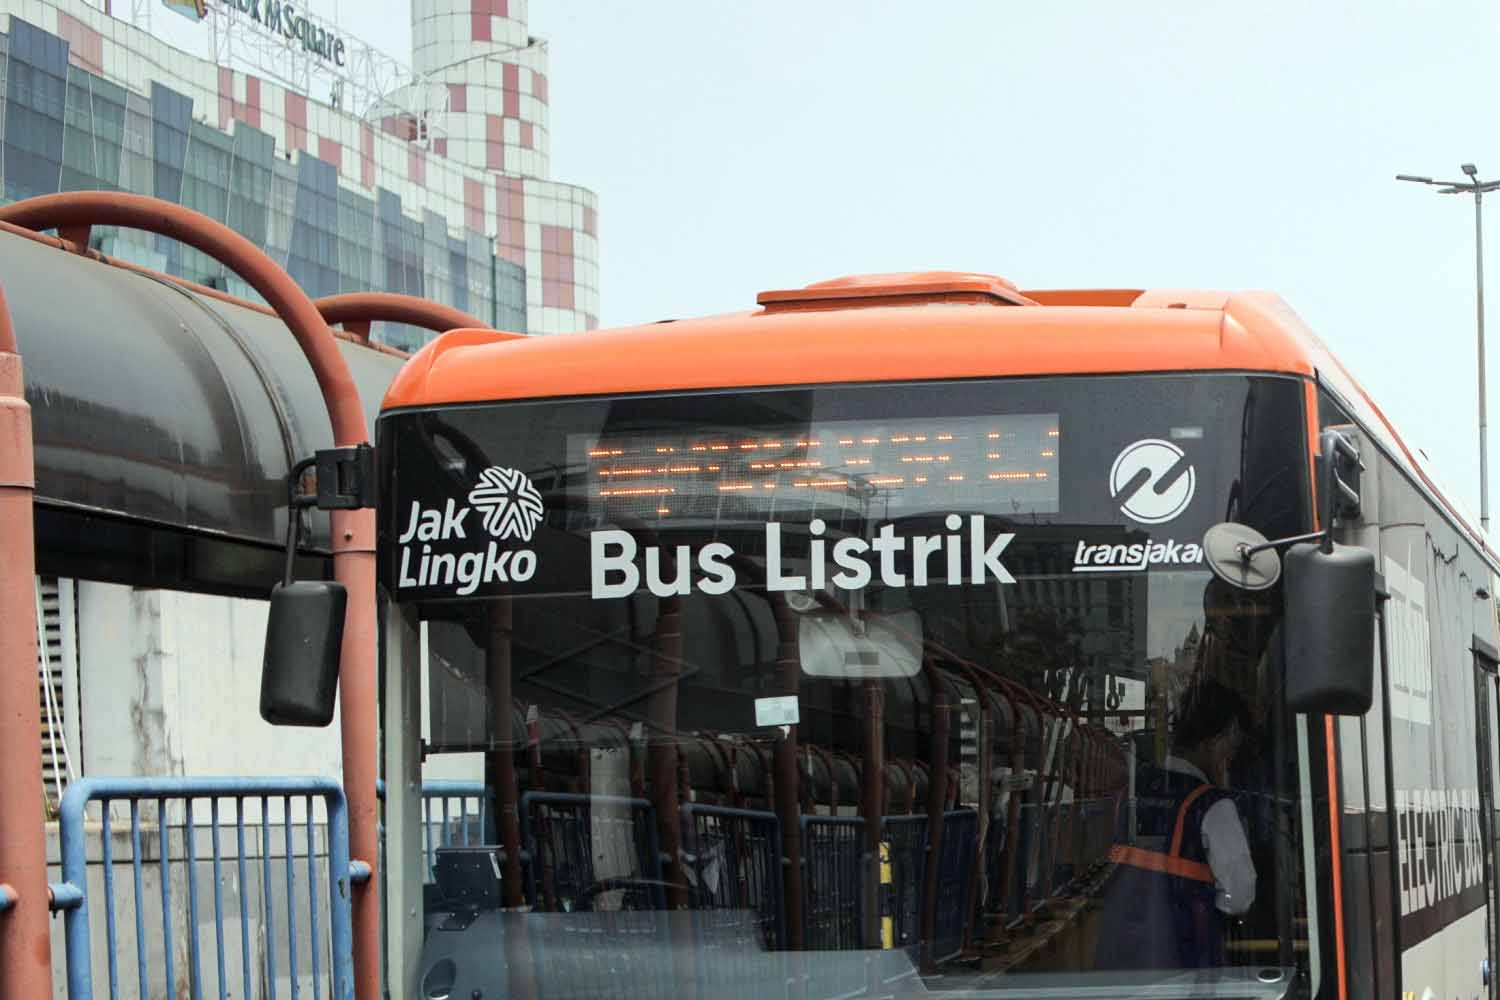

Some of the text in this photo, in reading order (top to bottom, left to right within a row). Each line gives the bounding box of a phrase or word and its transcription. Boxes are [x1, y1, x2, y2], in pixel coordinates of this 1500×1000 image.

[284, 5, 345, 66] Square
[399, 498, 470, 544] Jak
[399, 541, 537, 595] Lingko
[590, 514, 1017, 599] Bus Listrik
